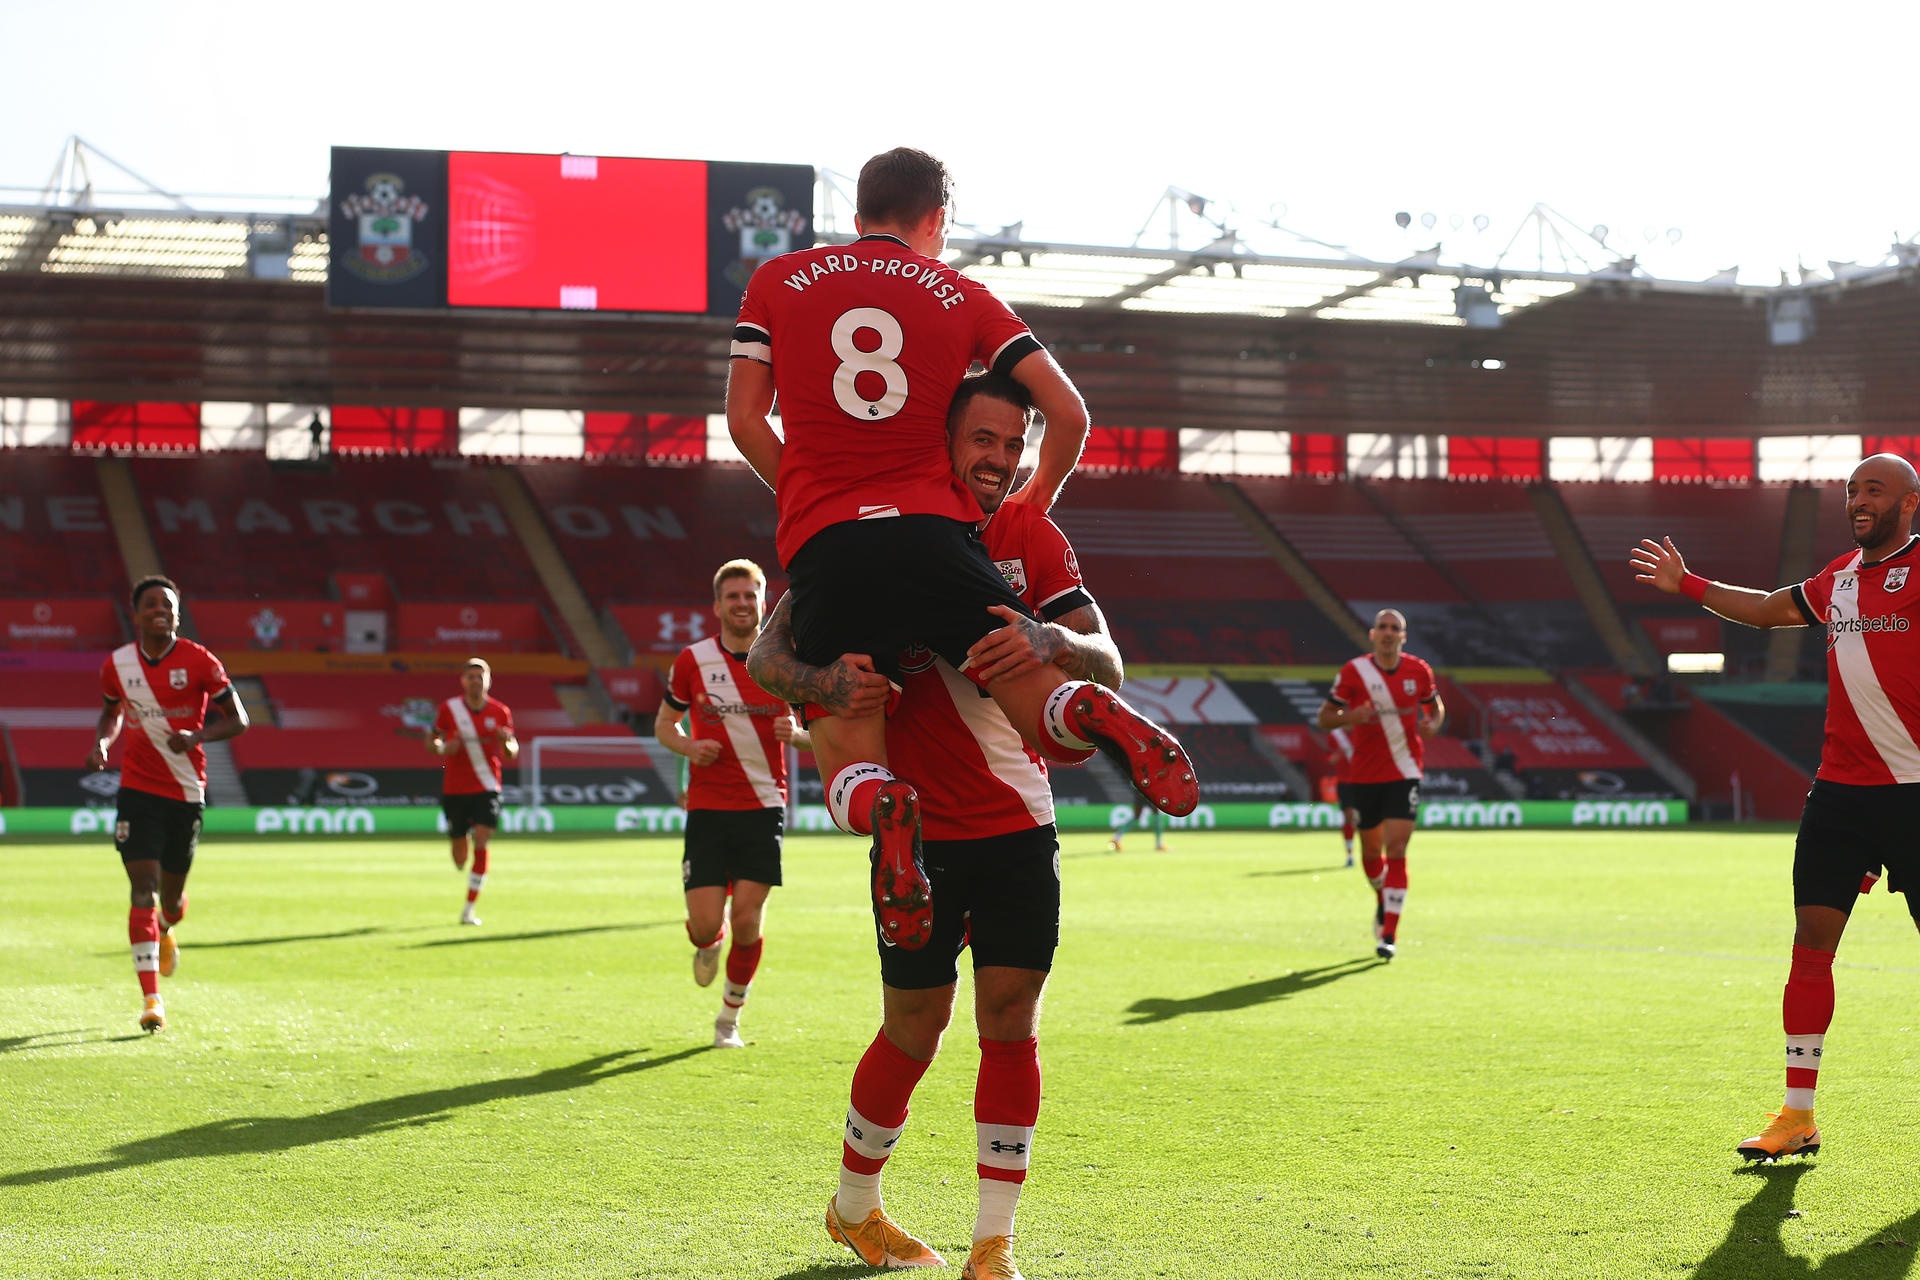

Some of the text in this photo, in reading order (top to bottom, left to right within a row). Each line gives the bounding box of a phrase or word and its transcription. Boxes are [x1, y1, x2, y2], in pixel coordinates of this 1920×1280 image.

[783, 253, 965, 310] WARD-PROWSE
[830, 306, 908, 421] 8
[153, 498, 508, 536] MARCH
[553, 504, 688, 540] ON
[1829, 613, 1910, 635] portsbet.io
